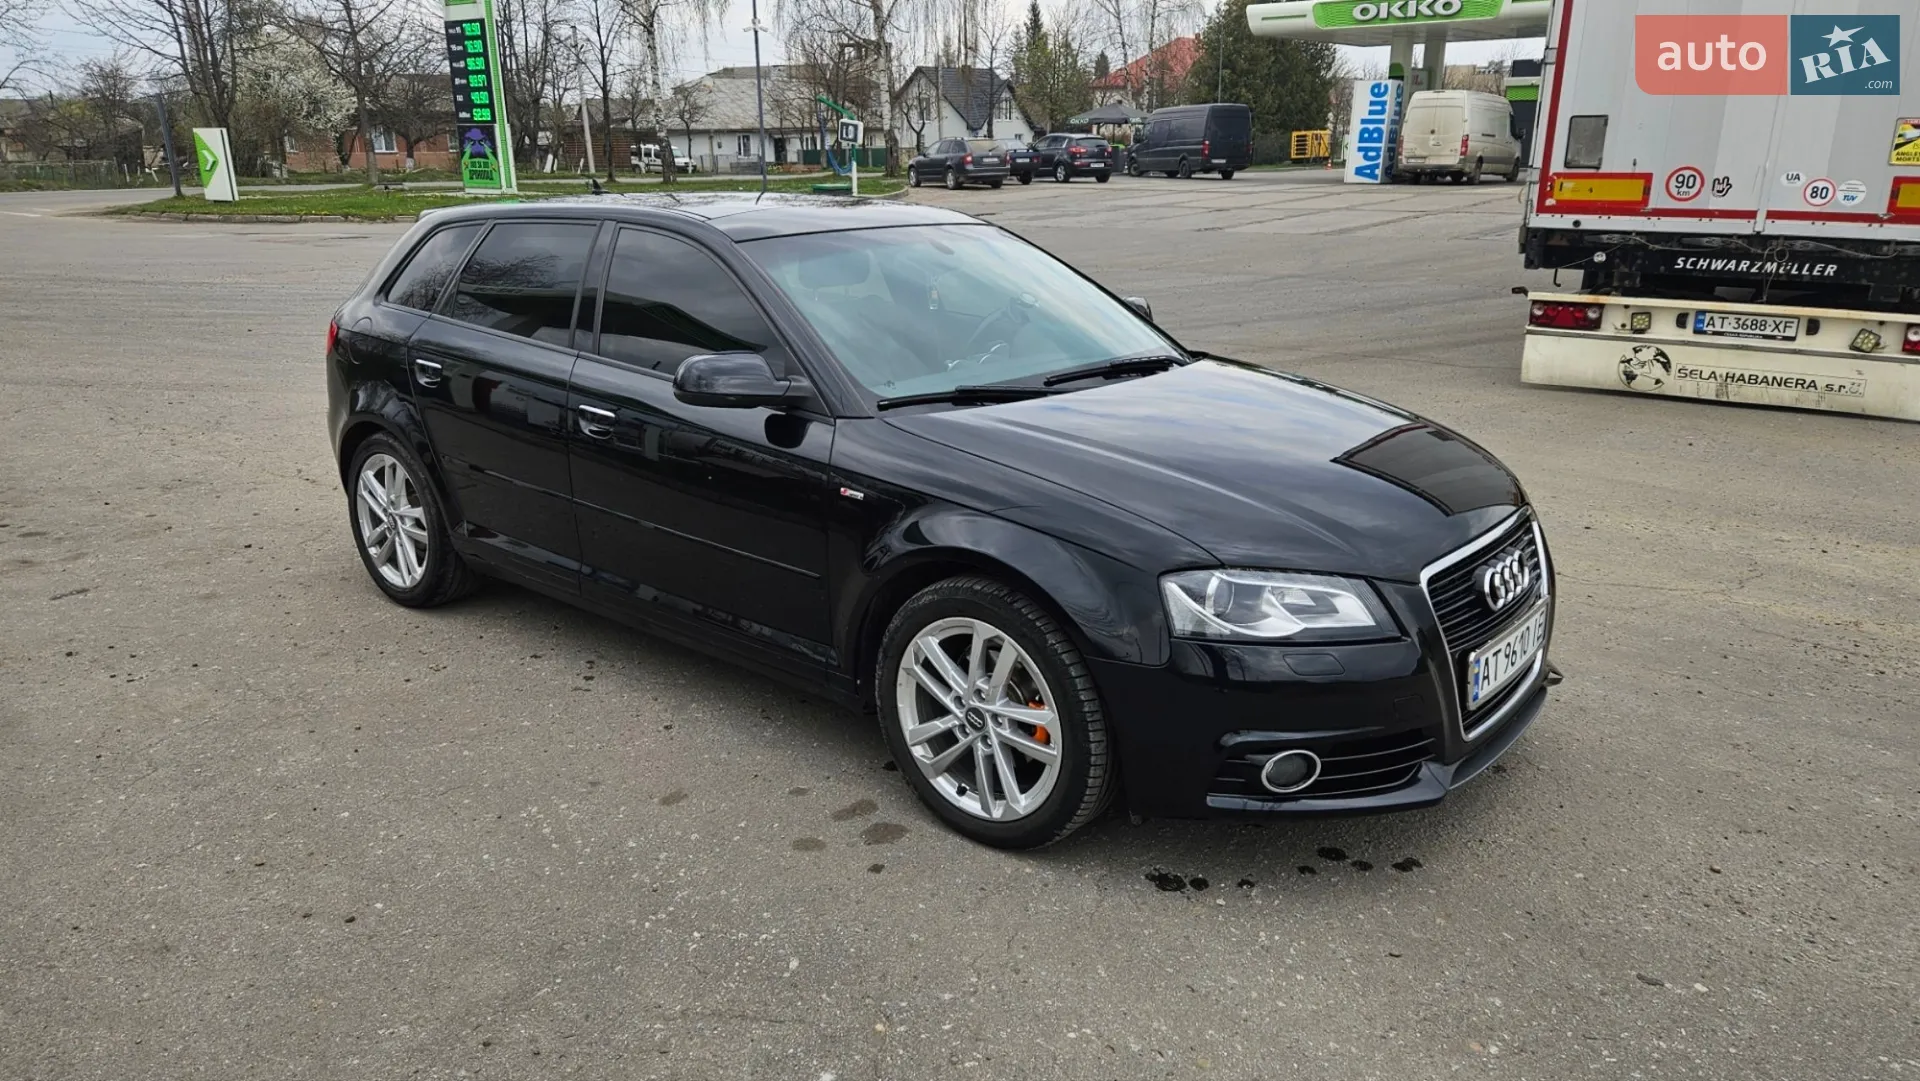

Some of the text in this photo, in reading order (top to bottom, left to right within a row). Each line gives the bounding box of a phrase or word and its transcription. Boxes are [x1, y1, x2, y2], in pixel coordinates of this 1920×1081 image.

[1352, 0, 1461, 21] OKKO
[1354, 82, 1389, 181] AdBlue
[1675, 174, 1697, 189] 90
[1786, 173, 1800, 181] UA
[1676, 188, 1690, 196] km
[1810, 186, 1829, 199] 80
[1724, 372, 1818, 390] HABANERA
